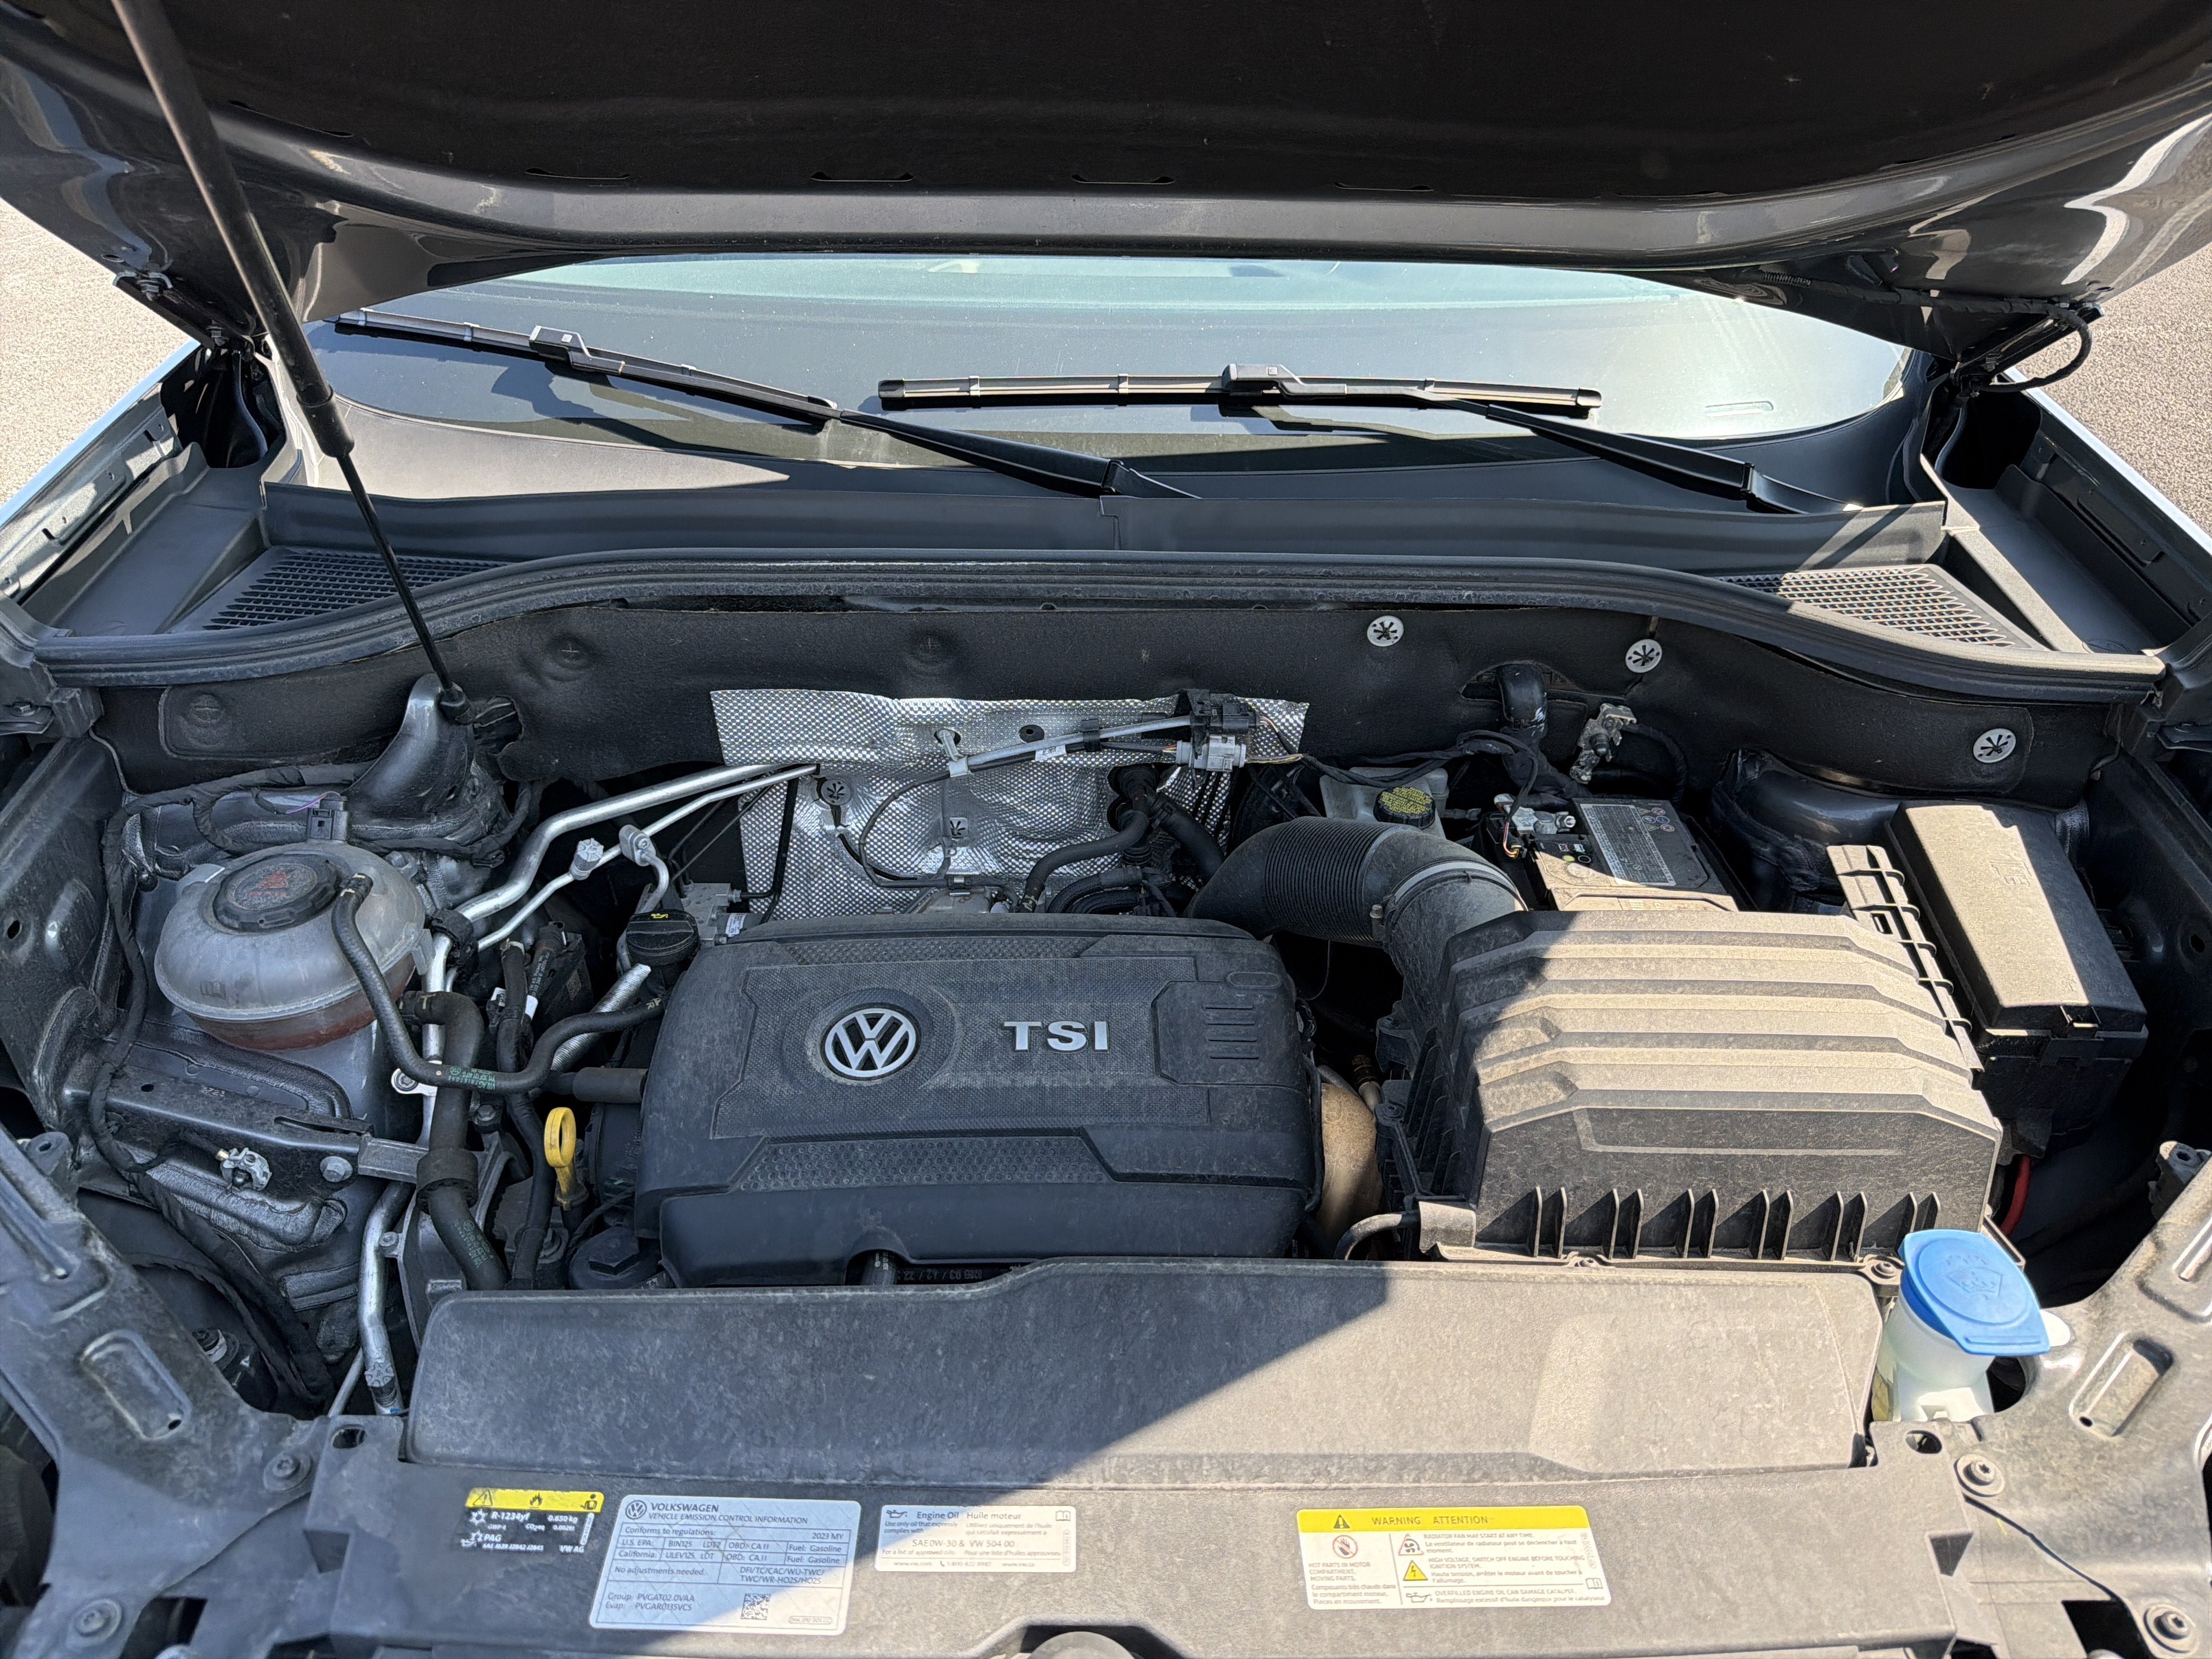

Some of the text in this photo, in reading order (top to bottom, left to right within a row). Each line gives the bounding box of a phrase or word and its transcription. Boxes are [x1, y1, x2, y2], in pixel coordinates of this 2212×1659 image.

[1003, 1020, 1110, 1053] TSI
[651, 1502, 719, 1513] VOLKSWAGEN
[491, 1512, 531, 1522] R-1234yf
[718, 1514, 753, 1522] CONTROL
[755, 1515, 808, 1524] INFORMATION
[917, 1511, 946, 1521] Engine
[967, 1511, 989, 1520] Huile
[1371, 1515, 1488, 1525] WARNING ATTENTION
[625, 1526, 661, 1534] Conforms
[672, 1528, 716, 1537] regulations:
[808, 1556, 840, 1564] Gasoline
[627, 1566, 674, 1576] adjustments
[676, 1567, 706, 1576] needed.
[607, 1592, 633, 1601] Group:
